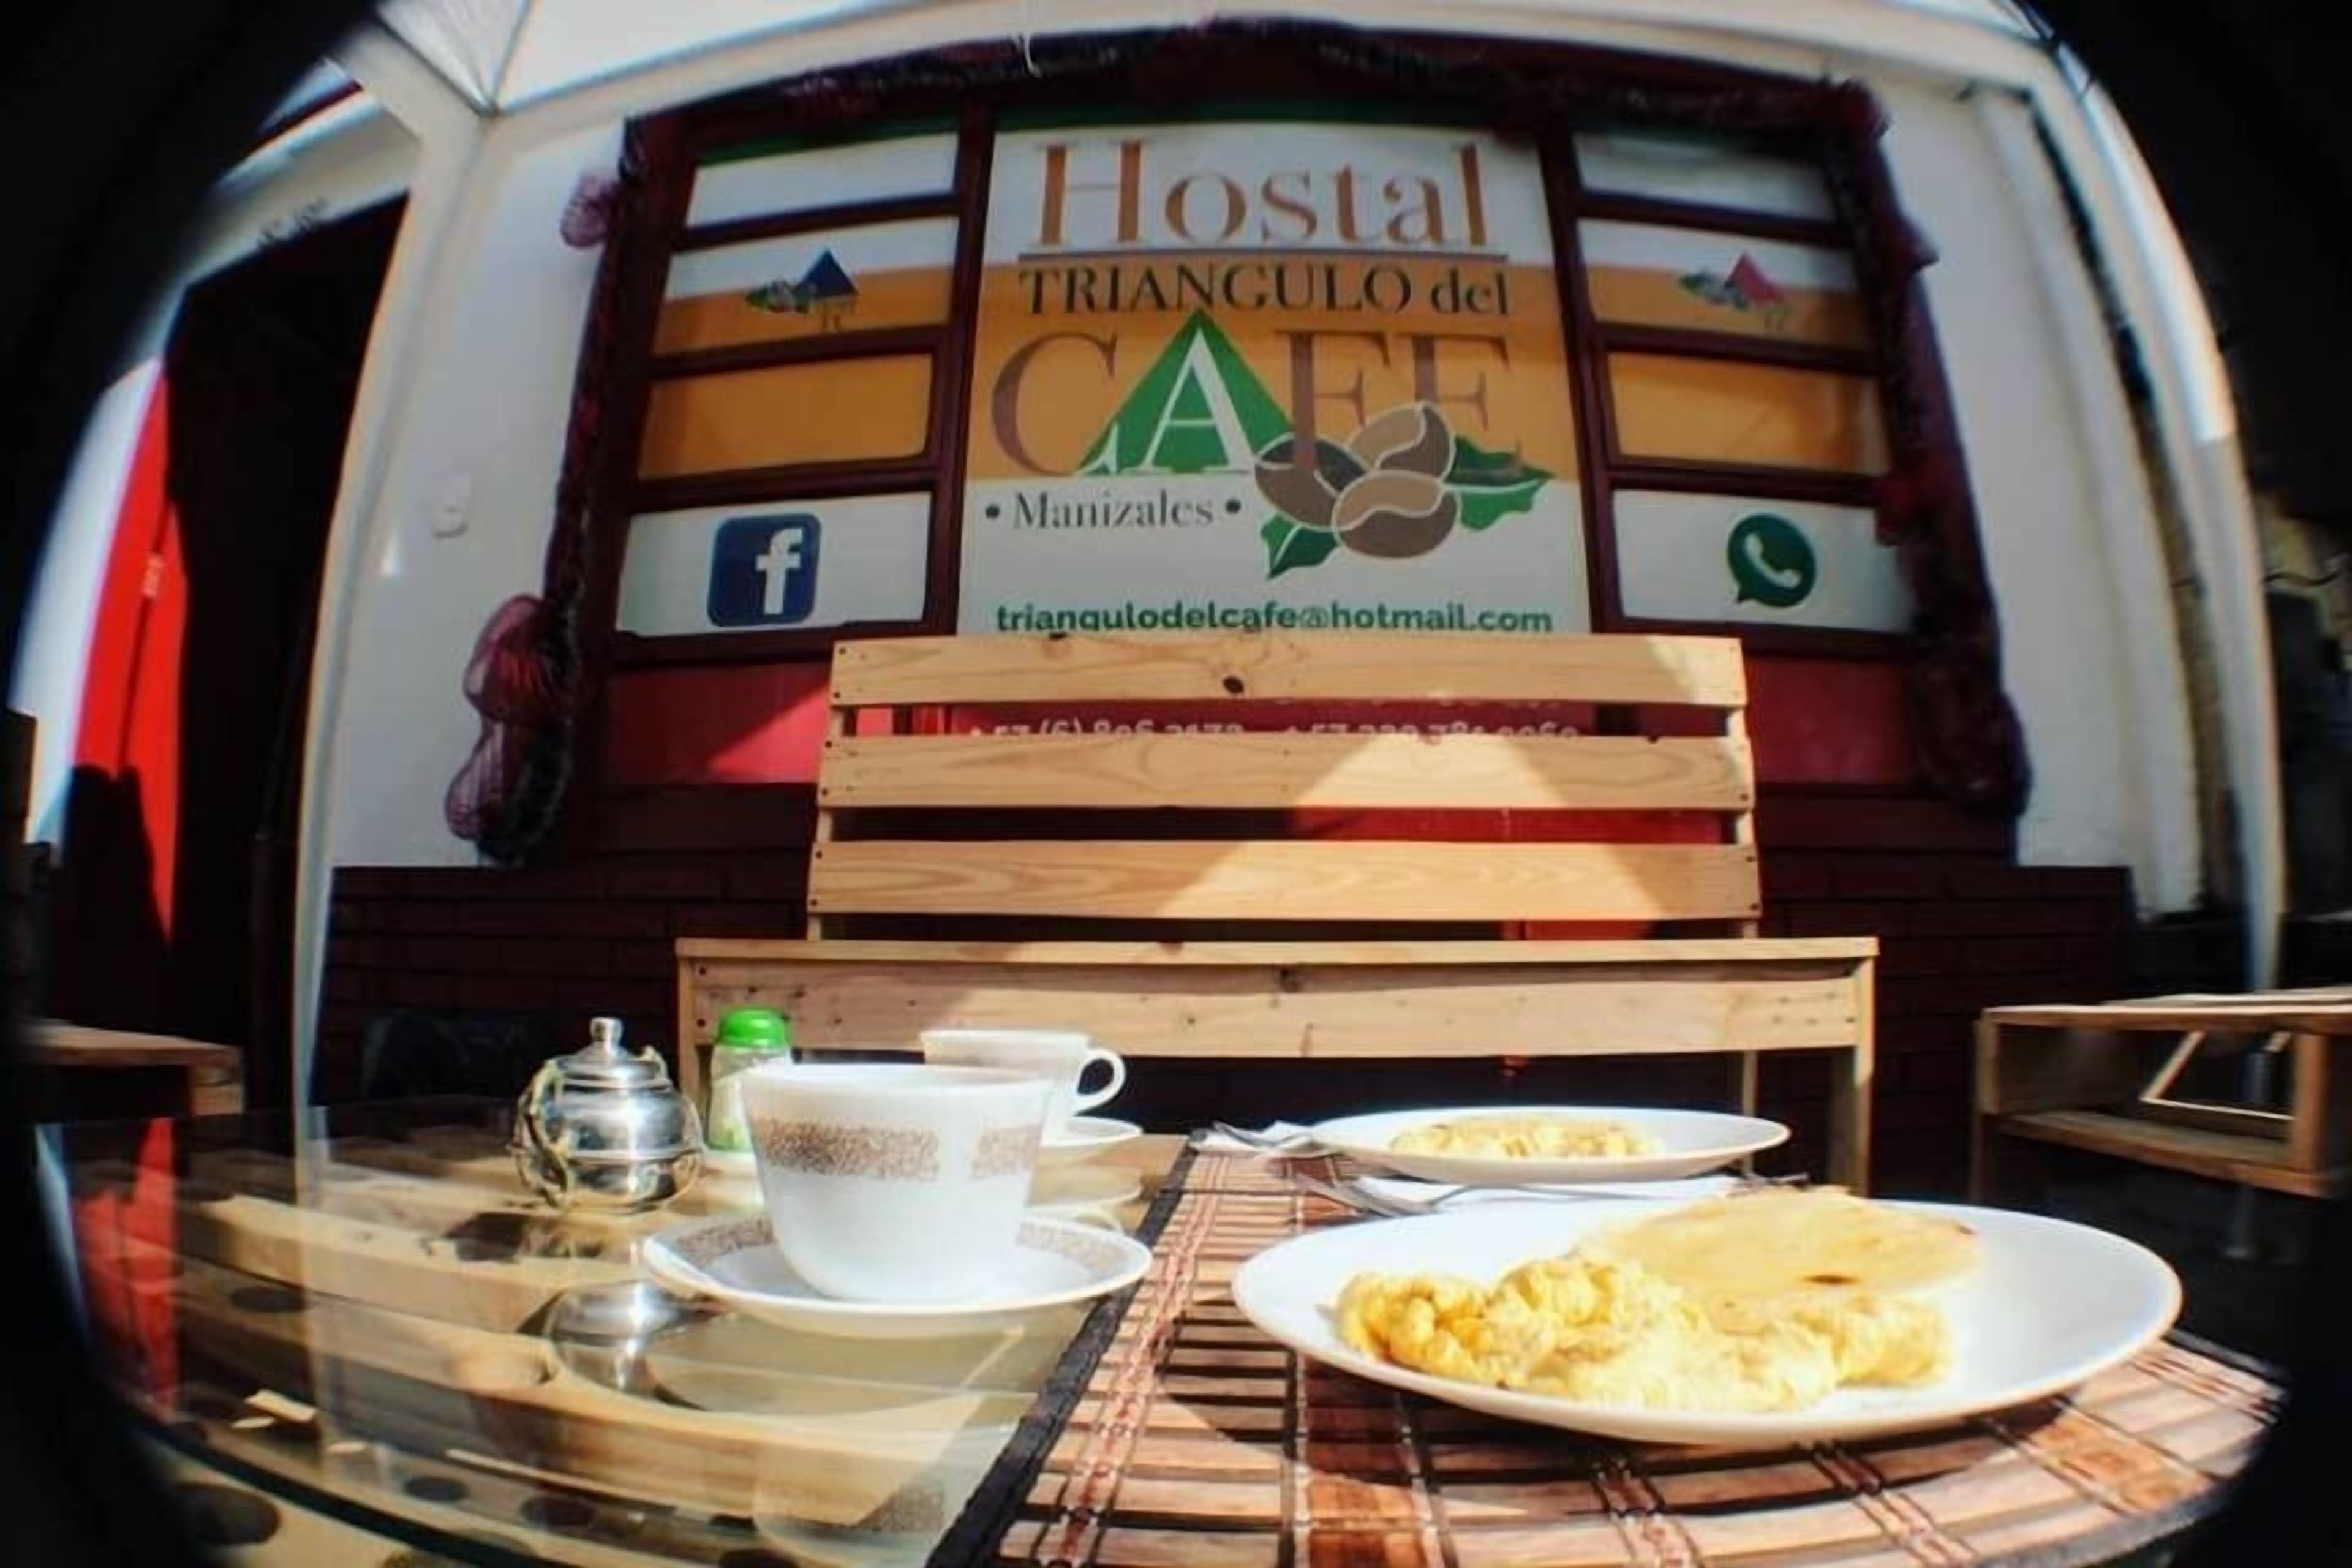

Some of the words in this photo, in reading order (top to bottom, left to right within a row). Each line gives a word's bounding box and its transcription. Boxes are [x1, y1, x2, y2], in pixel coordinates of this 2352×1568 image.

[1035, 140, 1488, 246] Hostal
[1019, 262, 1412, 315] TRIANGULO
[1430, 266, 1509, 315] del
[991, 328, 1523, 476] CAFE
[1012, 489, 1214, 530] Manizales
[756, 527, 803, 615] f
[997, 600, 1553, 631] triangulodelcafe@hotmail.com
